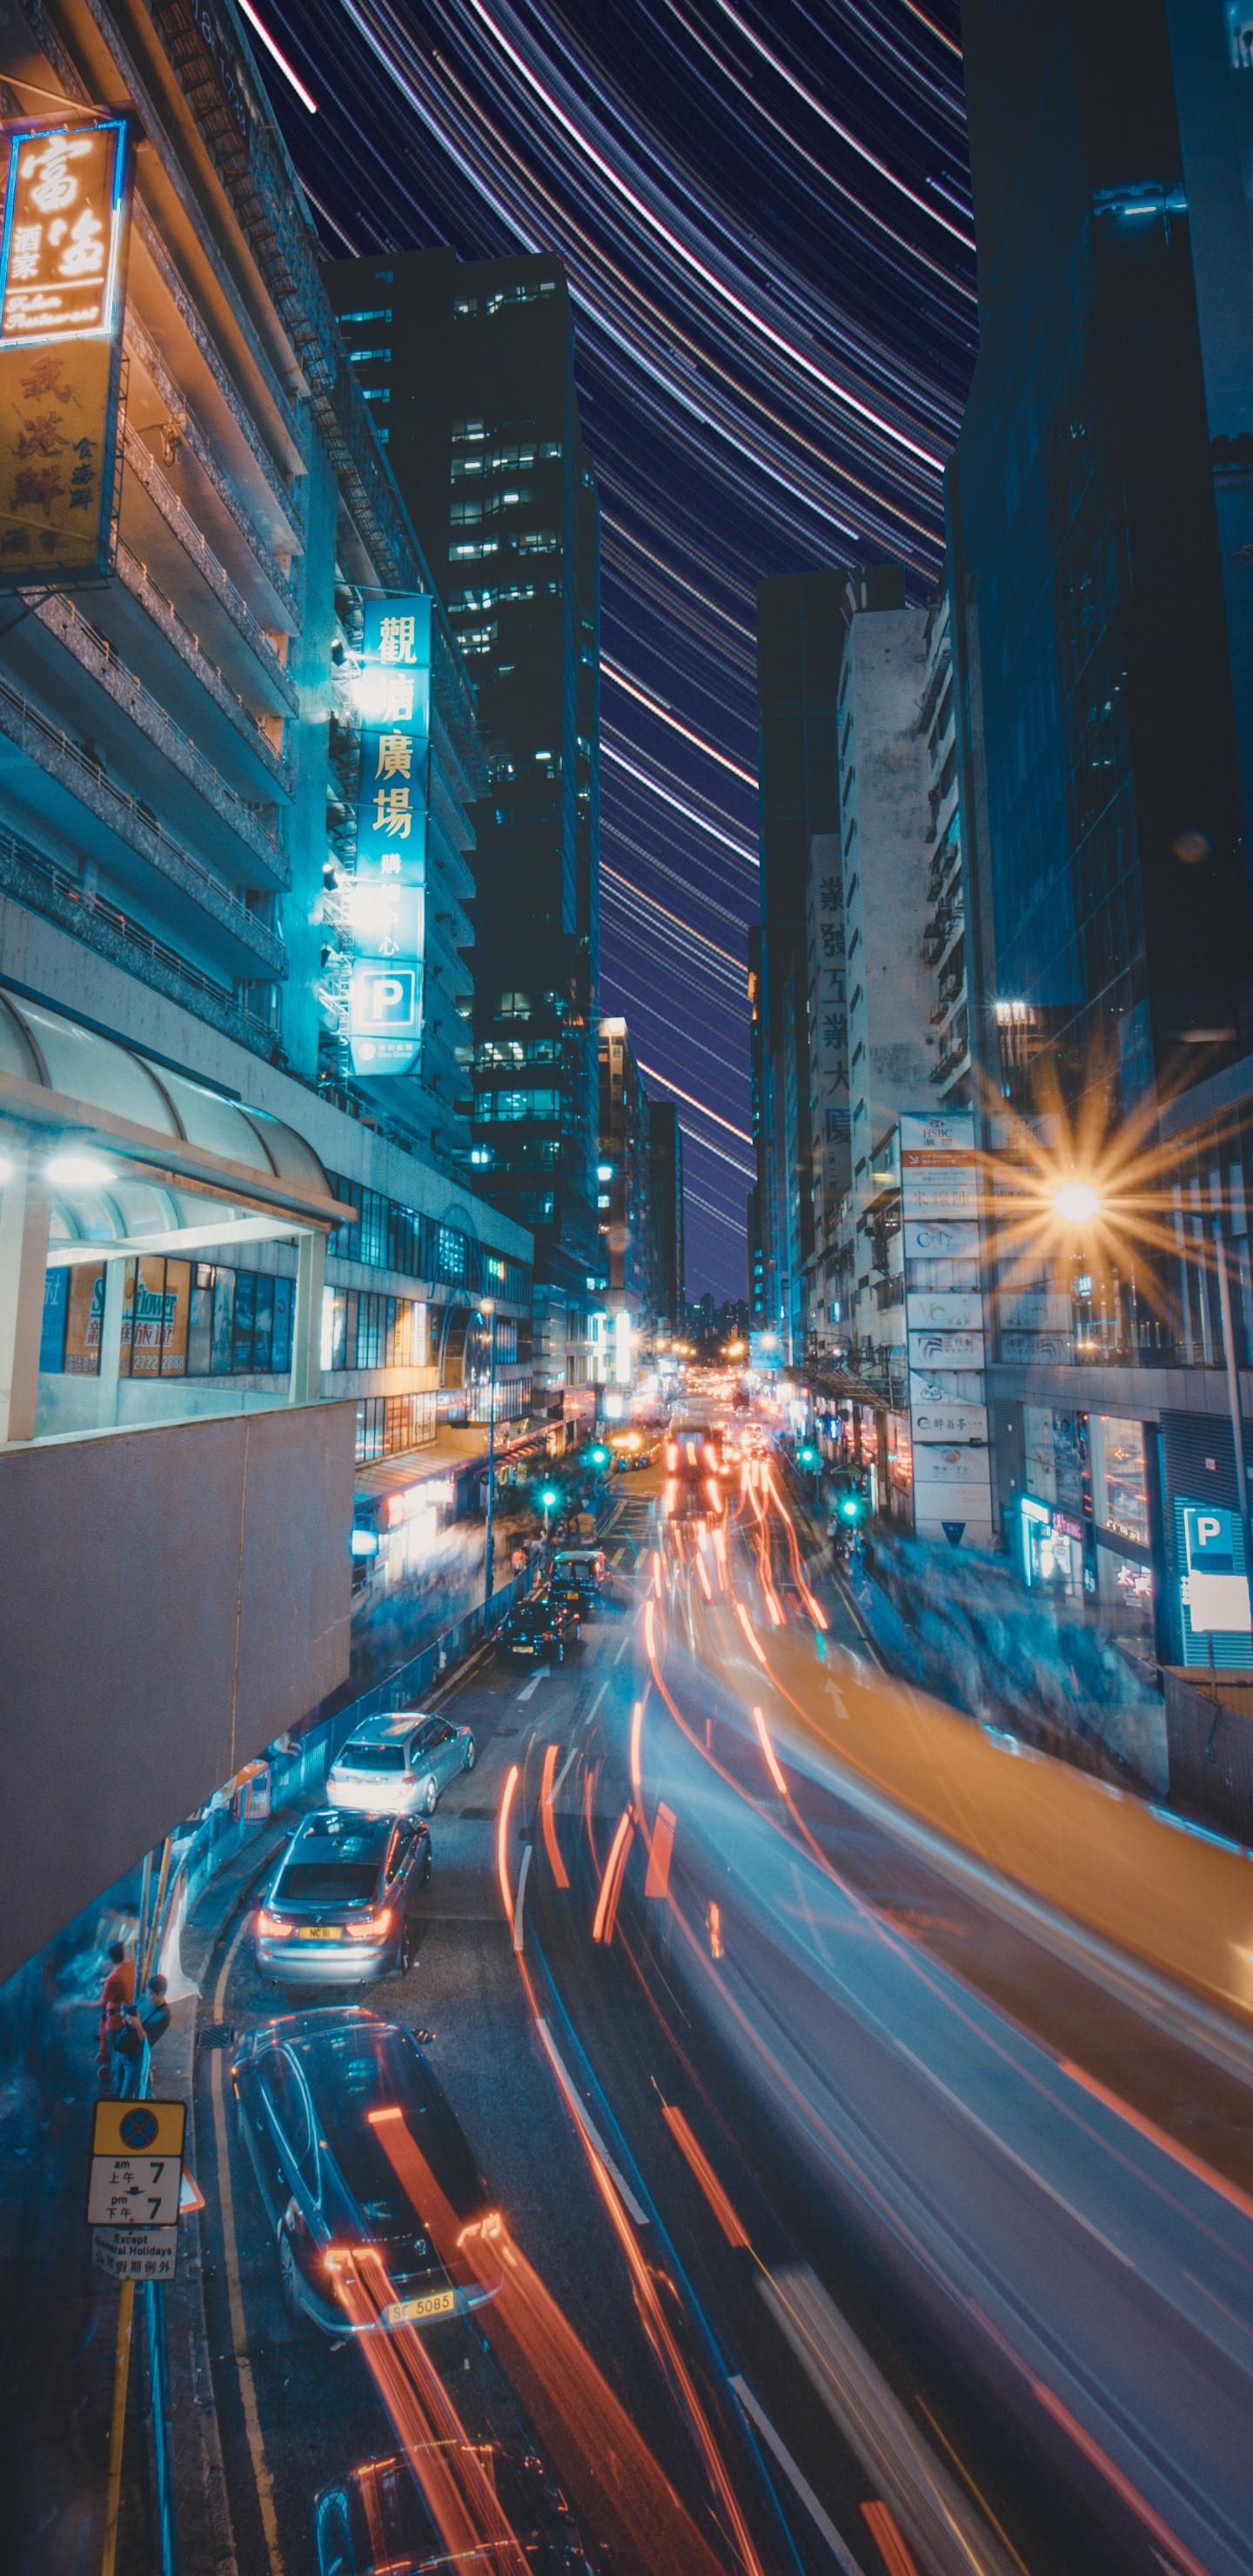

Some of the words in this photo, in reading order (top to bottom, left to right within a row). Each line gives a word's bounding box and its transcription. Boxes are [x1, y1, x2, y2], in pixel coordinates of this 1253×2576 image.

[4, 306, 99, 330] Restaurant
[372, 615, 418, 839] 觀塘廣場
[372, 979, 403, 1019] P
[923, 1129, 953, 1137] HSBC
[133, 1355, 157, 1370] 2722
[162, 1354, 184, 1370] 2888
[1197, 1517, 1221, 1546] P
[109, 2171, 134, 2184] 上午
[151, 2163, 164, 2184] 7
[111, 2197, 128, 2205] pm
[147, 2197, 162, 2219] 7
[106, 2207, 131, 2219] 下午
[95, 2237, 126, 2255] General
[130, 2246, 172, 2257] Holidays
[114, 2233, 148, 2244] Except
[417, 2295, 449, 2315] 5085
